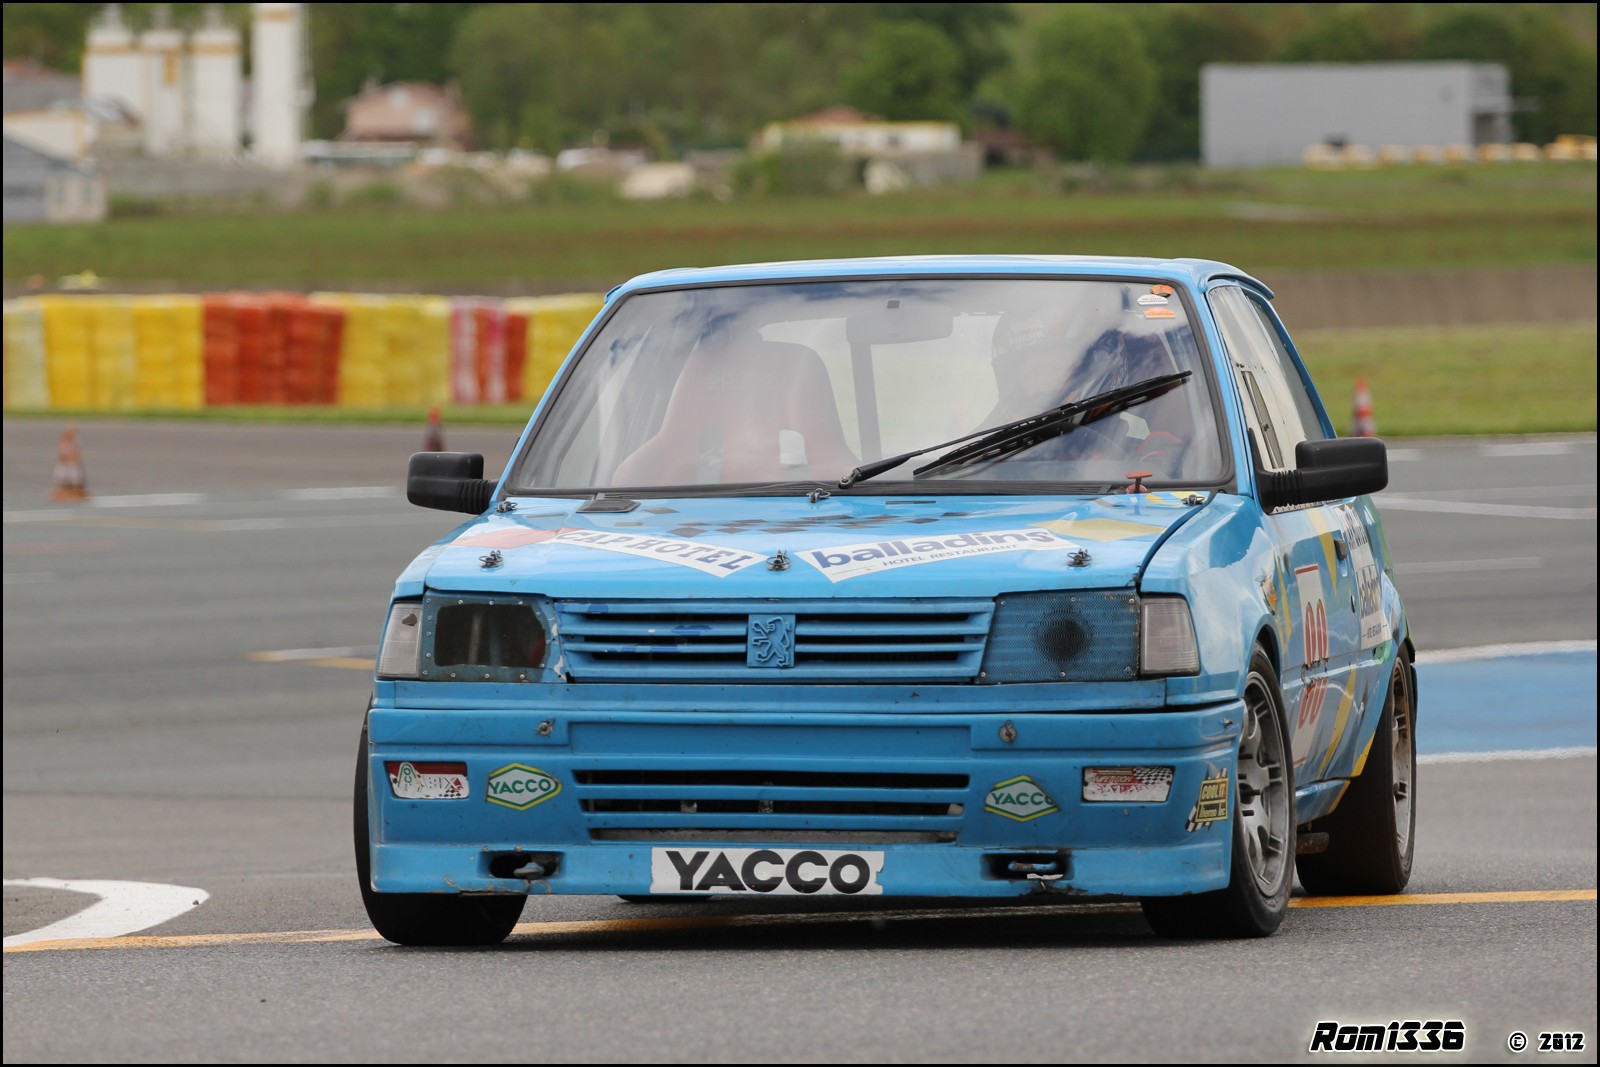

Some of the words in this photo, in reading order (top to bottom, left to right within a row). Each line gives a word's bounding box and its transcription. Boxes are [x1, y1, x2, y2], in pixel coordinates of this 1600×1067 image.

[812, 531, 1056, 568] balladins
[883, 556, 924, 567] HOTEL
[930, 544, 1017, 560] RESTAURANT
[488, 778, 552, 795] YACCO
[1202, 784, 1218, 800] COOL
[1219, 783, 1226, 797] IT
[665, 850, 870, 894] YACCO
